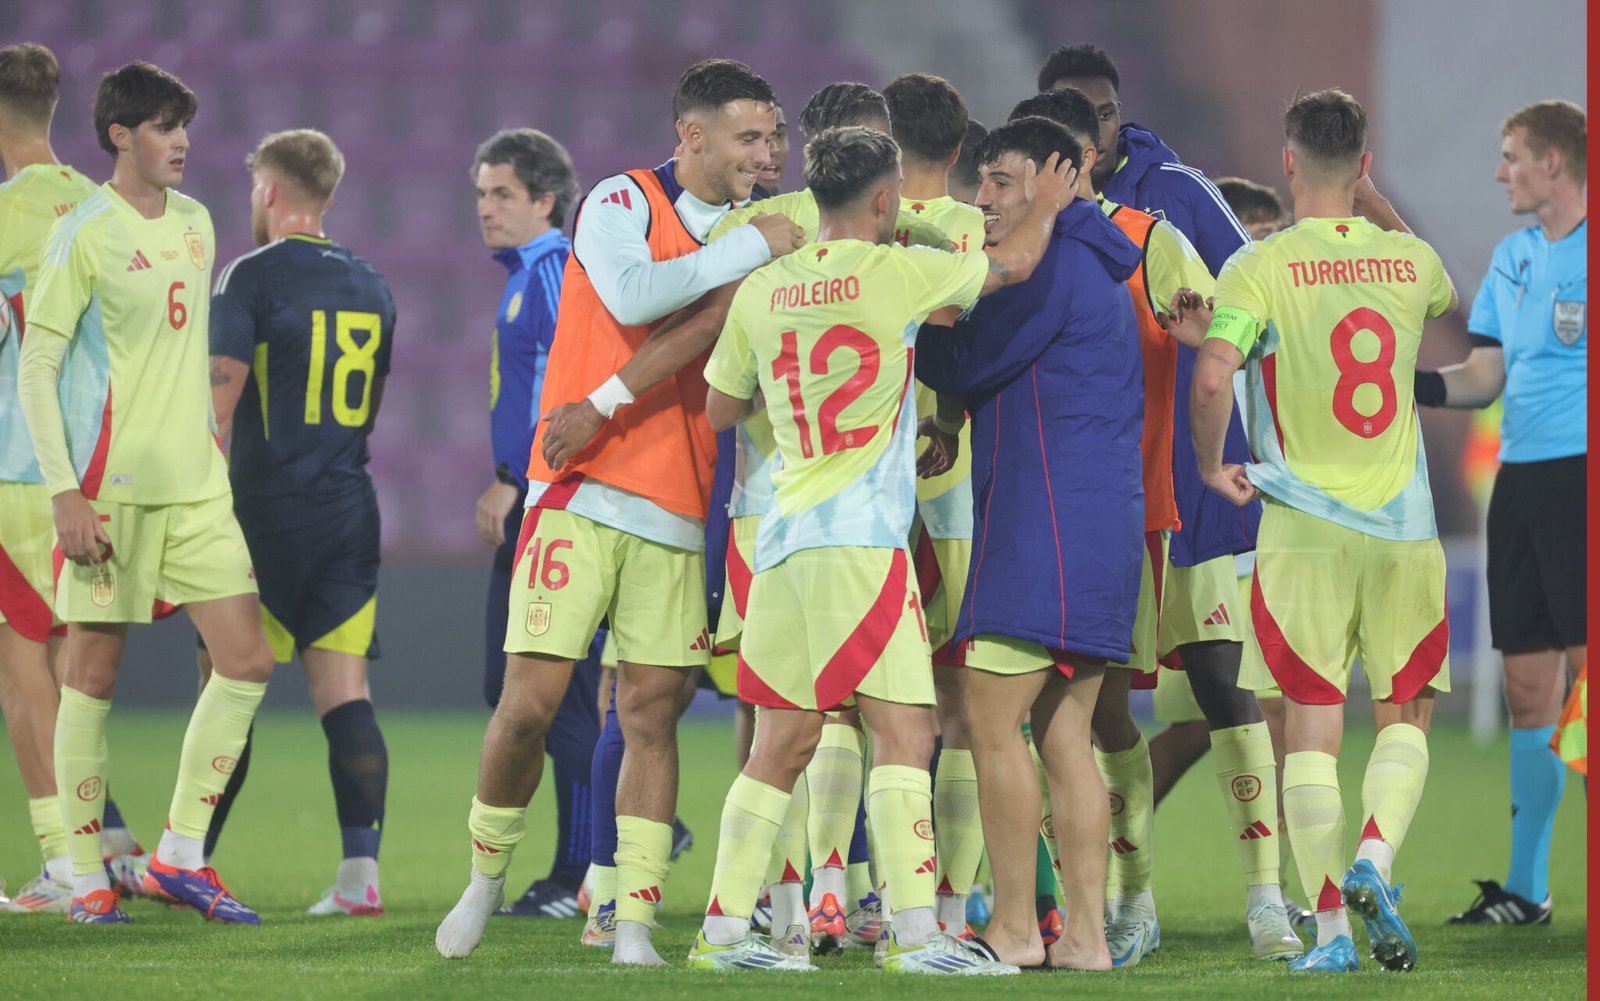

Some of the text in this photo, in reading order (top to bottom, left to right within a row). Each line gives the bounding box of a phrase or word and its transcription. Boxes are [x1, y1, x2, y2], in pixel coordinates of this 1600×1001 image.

[770, 275, 860, 312] MOLEIRO
[1288, 258, 1416, 287] TURRIENTES
[168, 281, 187, 330] 6
[304, 309, 382, 427] 18
[771, 324, 880, 459] 12
[1330, 306, 1398, 439] 8
[527, 537, 573, 591] 16
